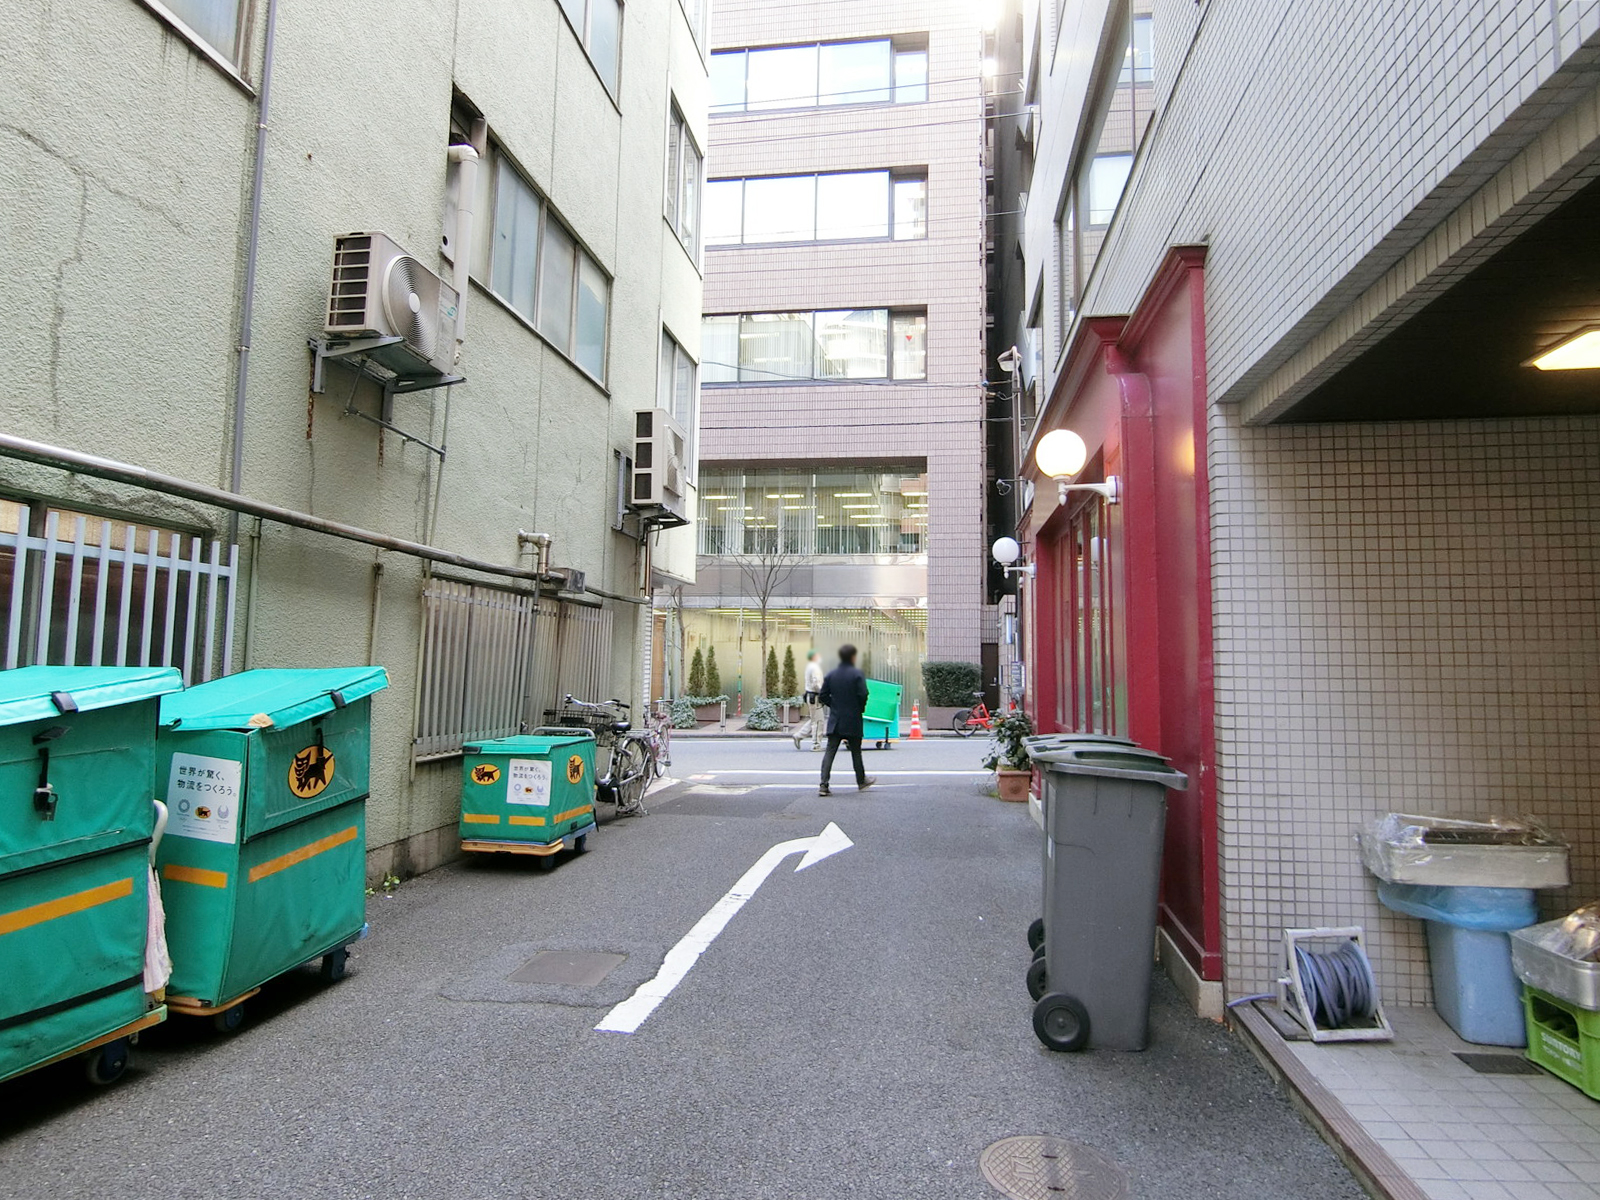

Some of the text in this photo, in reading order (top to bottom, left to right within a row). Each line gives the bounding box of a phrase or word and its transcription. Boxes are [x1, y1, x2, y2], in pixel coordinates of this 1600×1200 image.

[179, 766, 225, 781] 世界が驚く、
[177, 779, 237, 797] 物流をつくろう。
